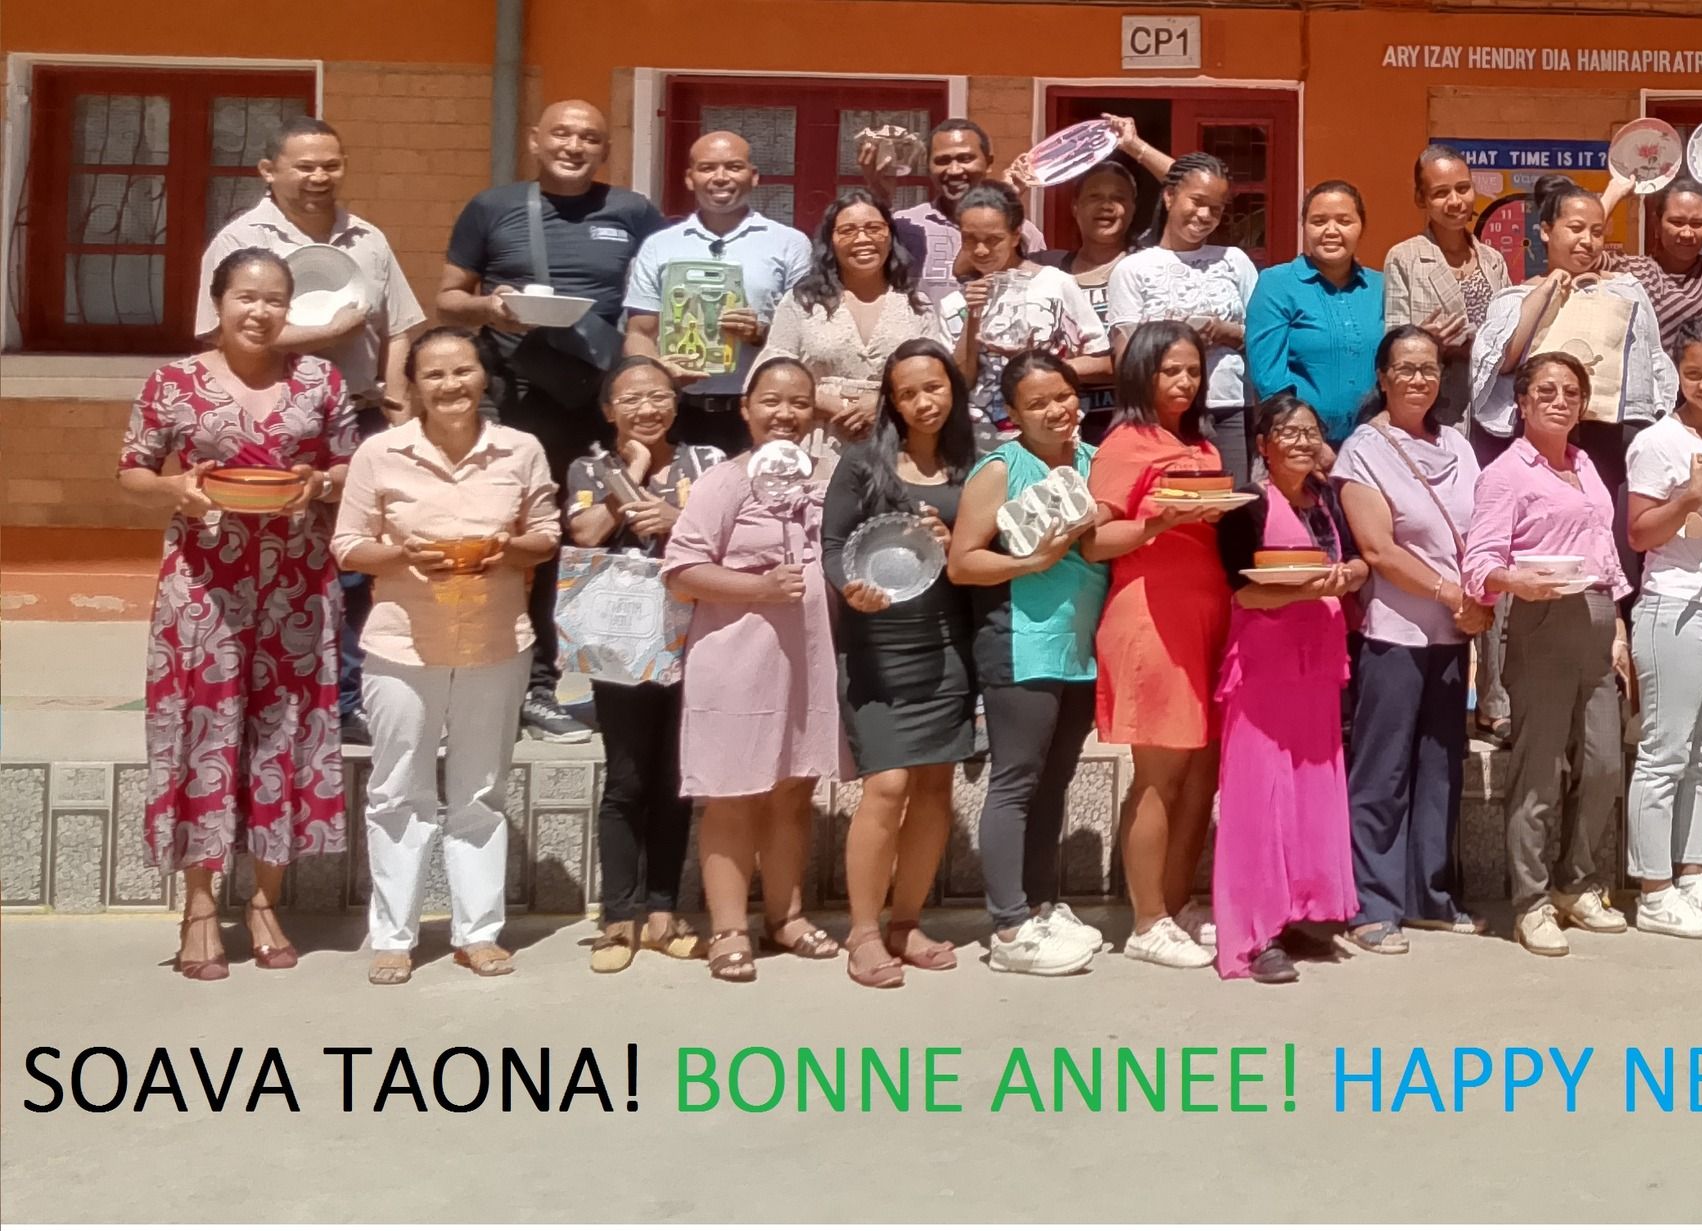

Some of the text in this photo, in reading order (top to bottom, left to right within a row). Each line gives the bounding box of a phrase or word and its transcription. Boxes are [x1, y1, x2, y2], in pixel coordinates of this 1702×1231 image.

[1130, 26, 1188, 56] CP1
[1382, 45, 1421, 68] ARY
[1424, 45, 1463, 69] IZAY
[1468, 46, 1537, 70] HENDRY
[1541, 48, 1571, 71] DIA
[1461, 150, 1498, 166] HAT
[1509, 151, 1550, 167] TIME
[1557, 151, 1573, 167] IS
[1501, 208, 1512, 220] 11
[1489, 221, 1502, 233] 10
